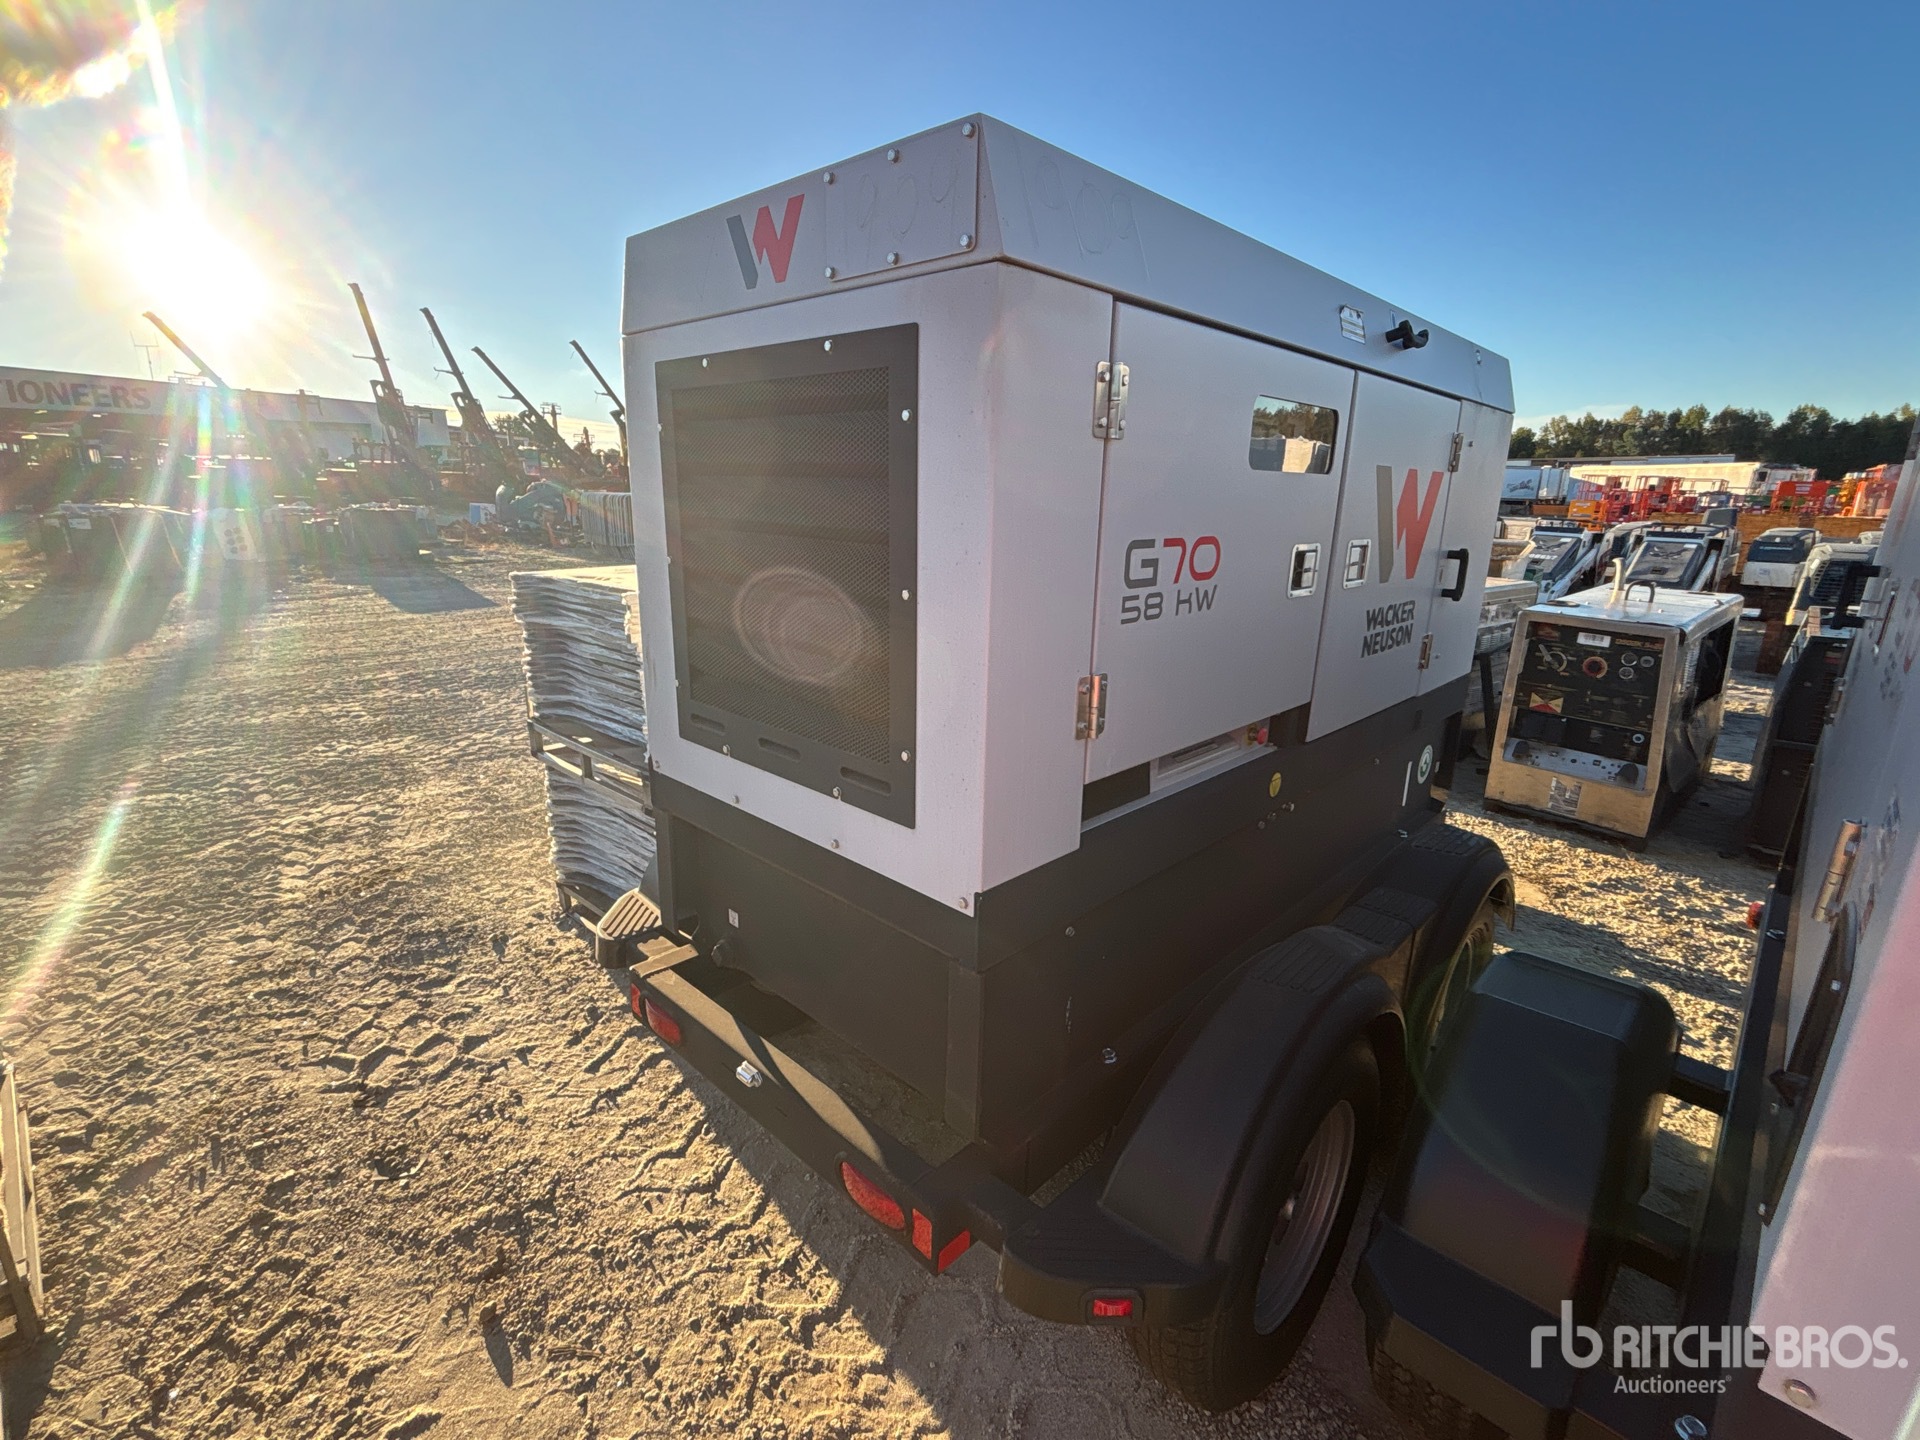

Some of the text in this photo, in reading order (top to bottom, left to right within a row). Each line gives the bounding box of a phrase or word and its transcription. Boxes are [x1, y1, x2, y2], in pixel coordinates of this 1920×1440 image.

[0, 378, 151, 410] IONEERS
[1123, 536, 1221, 590] G70
[1120, 592, 1164, 625] 58
[1366, 600, 1416, 632] WACKER
[1360, 623, 1414, 658] NEUSON
